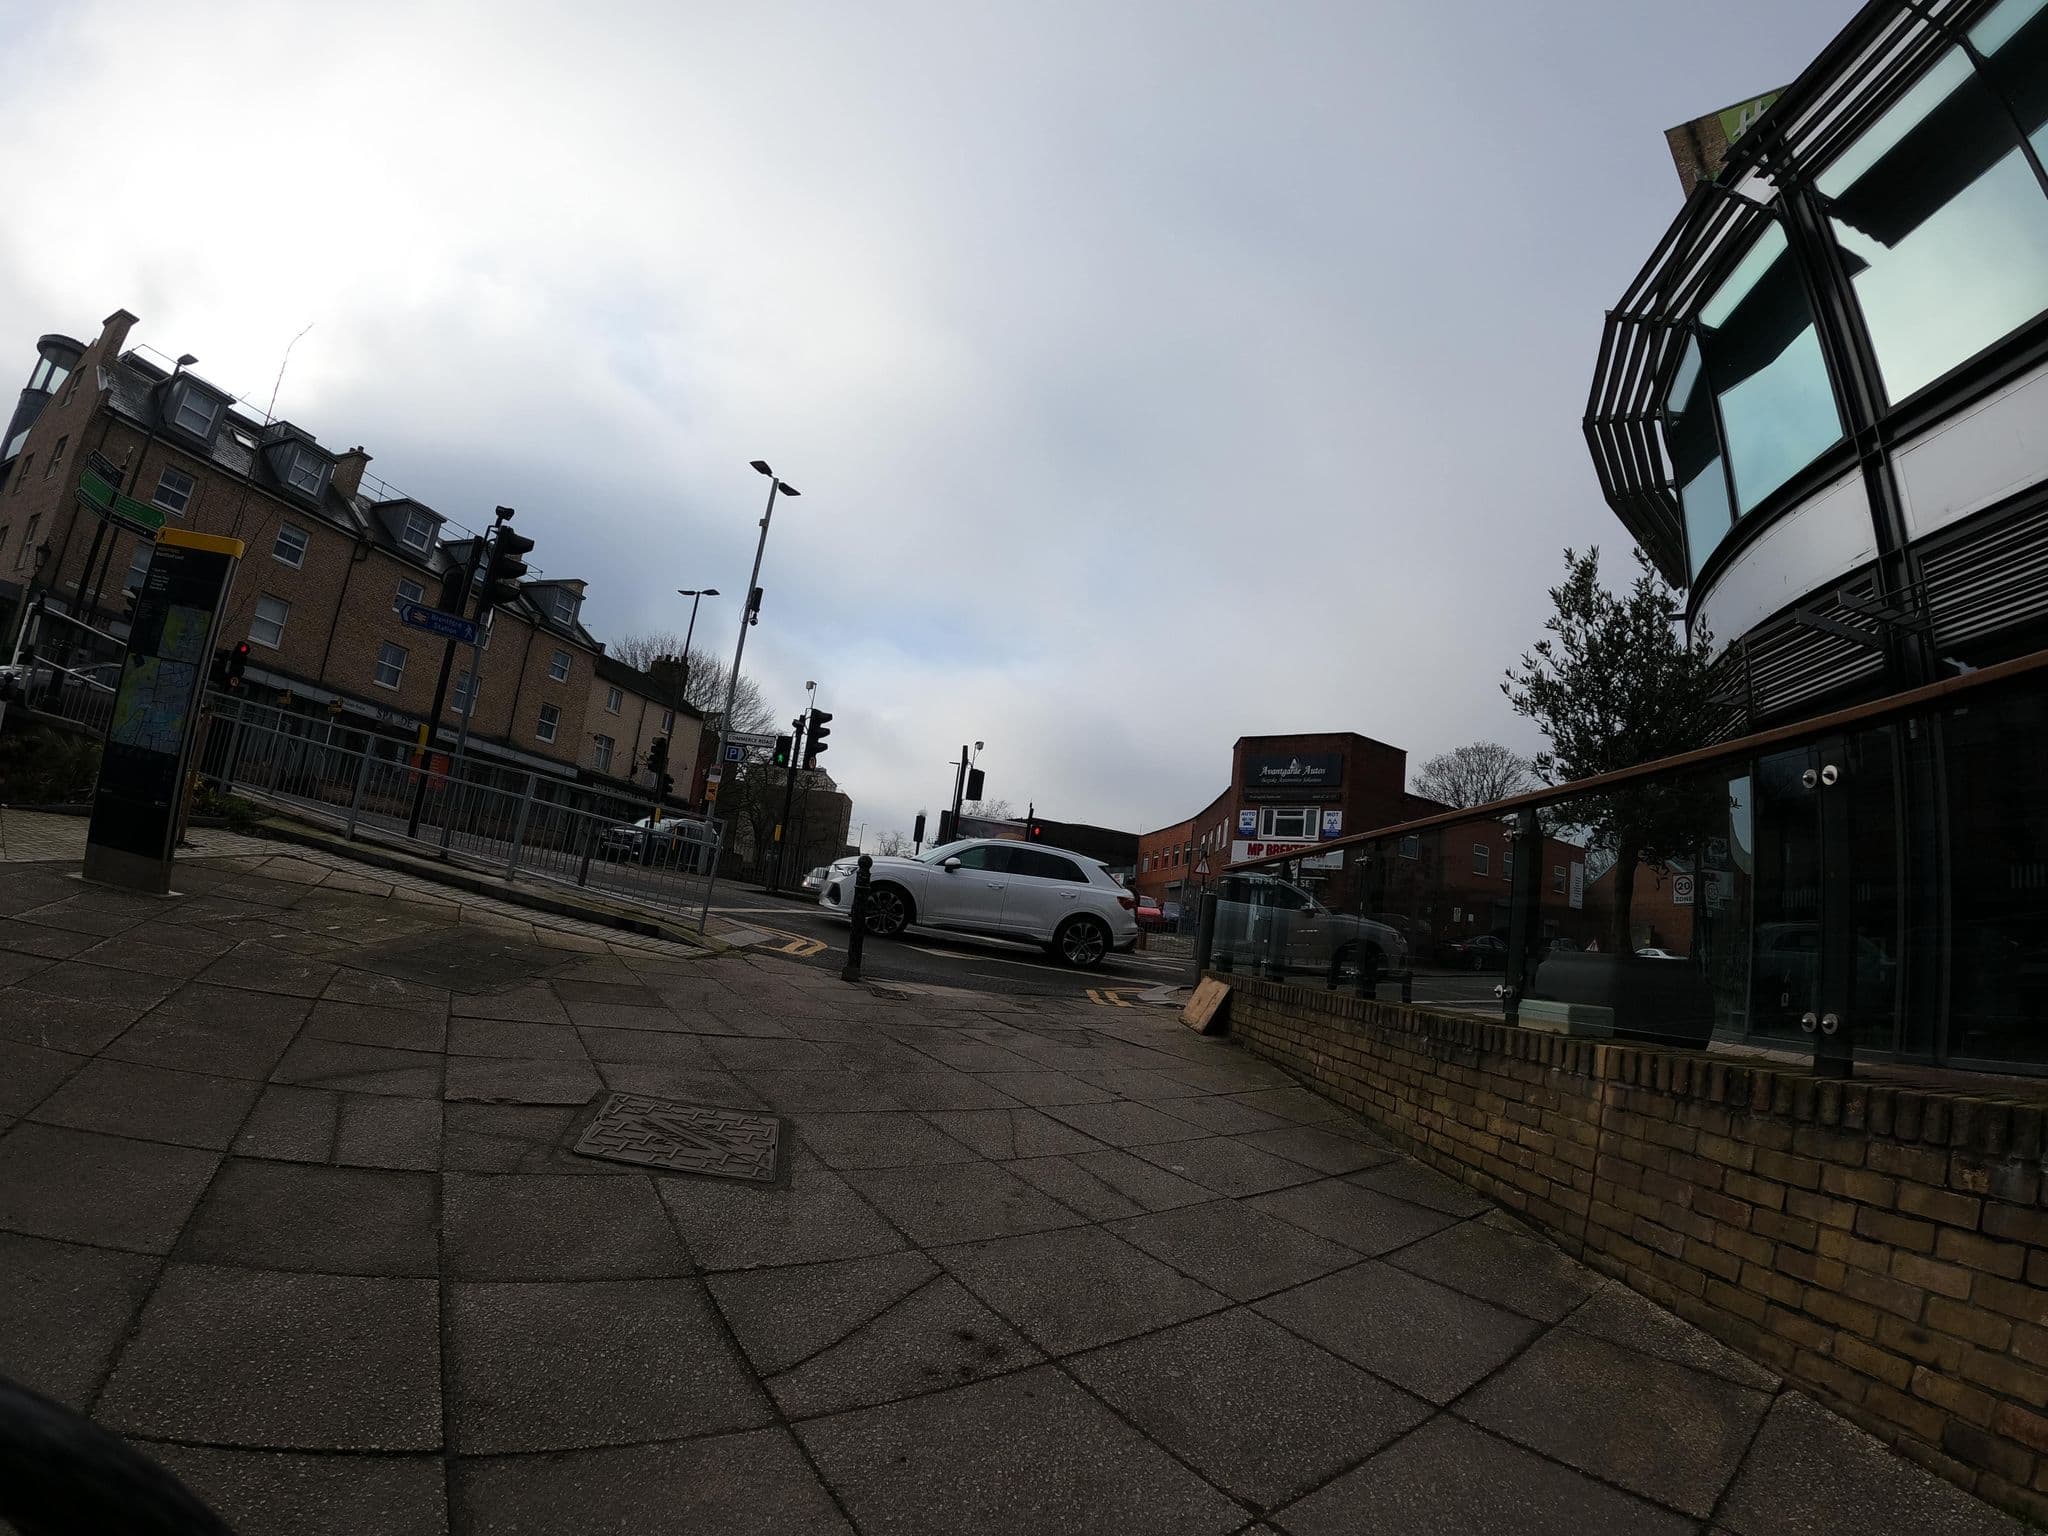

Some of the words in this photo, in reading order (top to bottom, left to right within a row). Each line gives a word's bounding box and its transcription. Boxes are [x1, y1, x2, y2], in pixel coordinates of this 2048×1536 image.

[728, 735, 757, 743] COMMERCE
[1677, 881, 1691, 891] 20
[1674, 895, 1693, 903] ZONE
